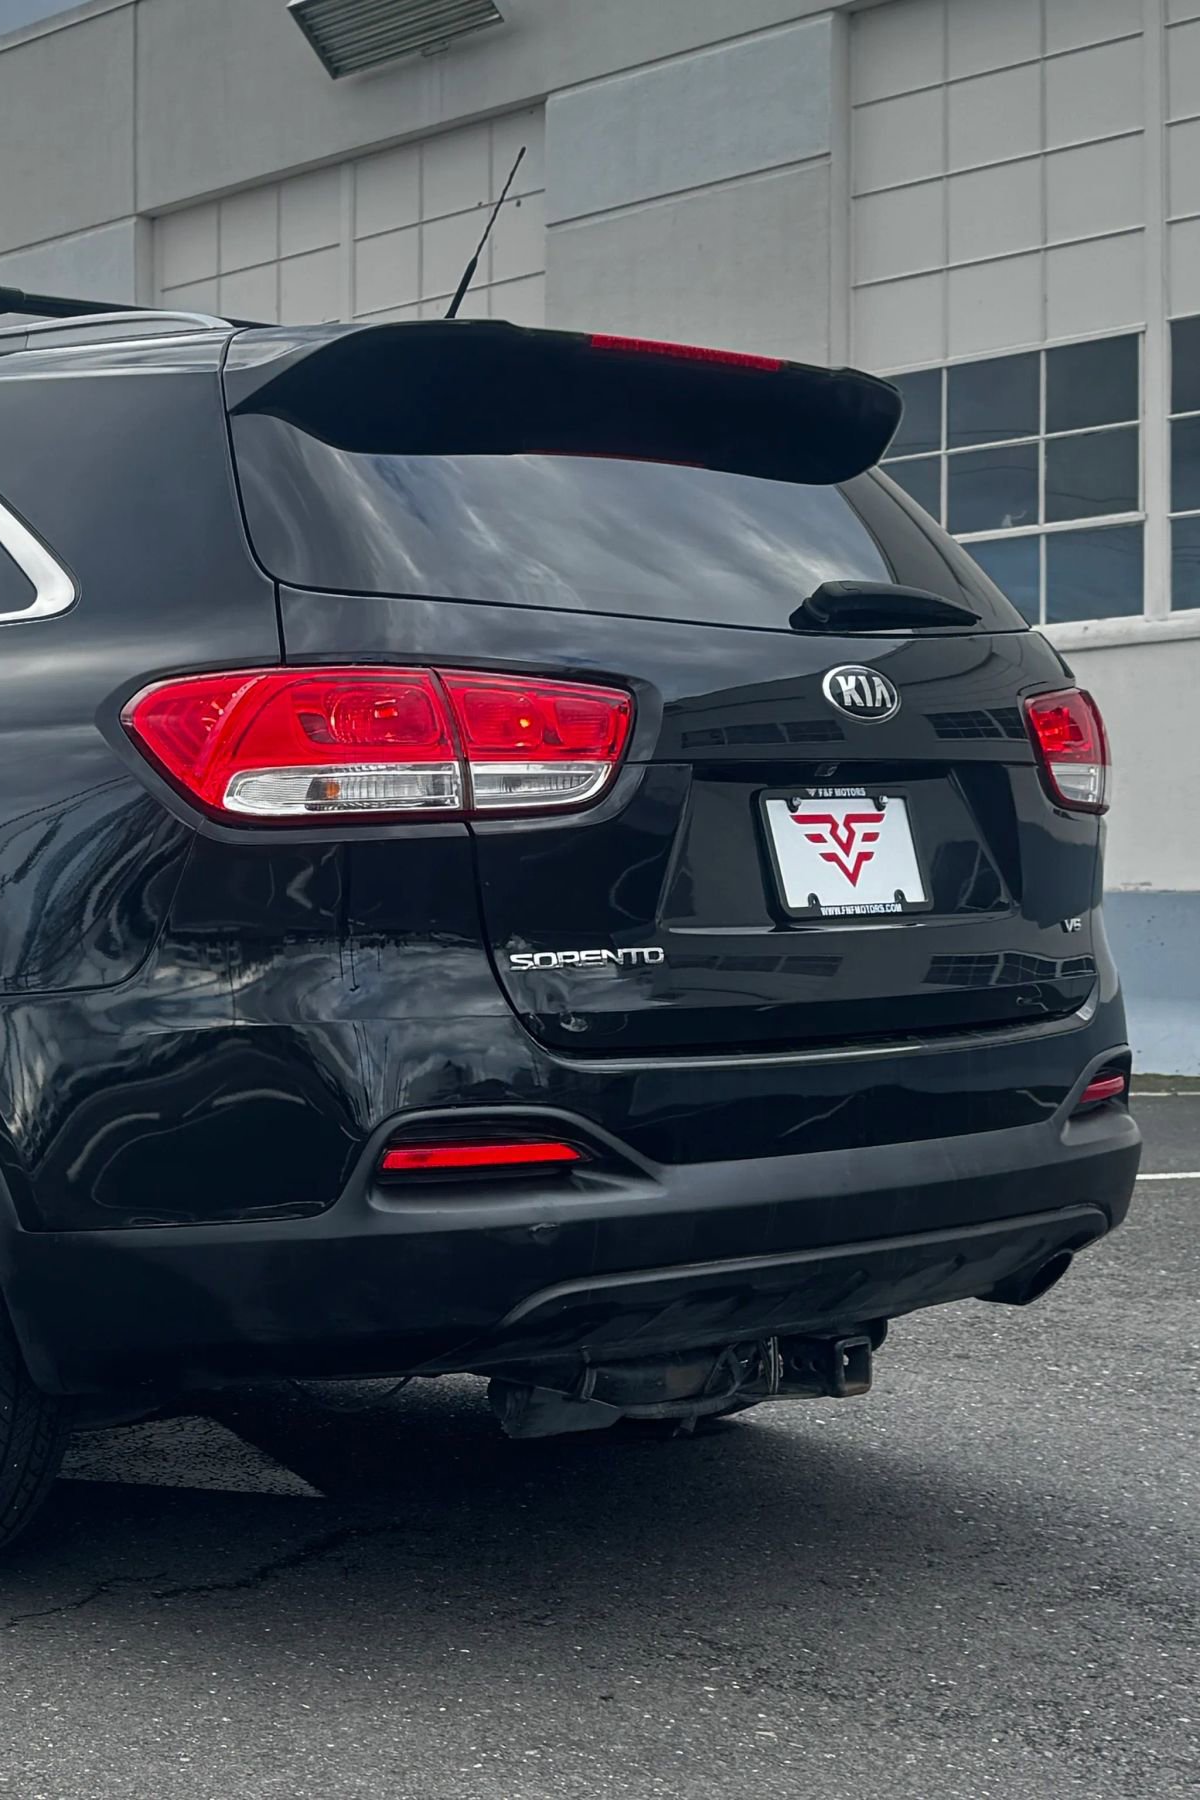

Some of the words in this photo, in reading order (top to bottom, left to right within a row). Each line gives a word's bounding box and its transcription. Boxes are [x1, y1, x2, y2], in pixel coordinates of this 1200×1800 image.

[835, 675, 892, 708] KIA
[834, 787, 866, 797] MOTORS
[1064, 917, 1082, 933] V6
[510, 947, 665, 971] SORENTO
